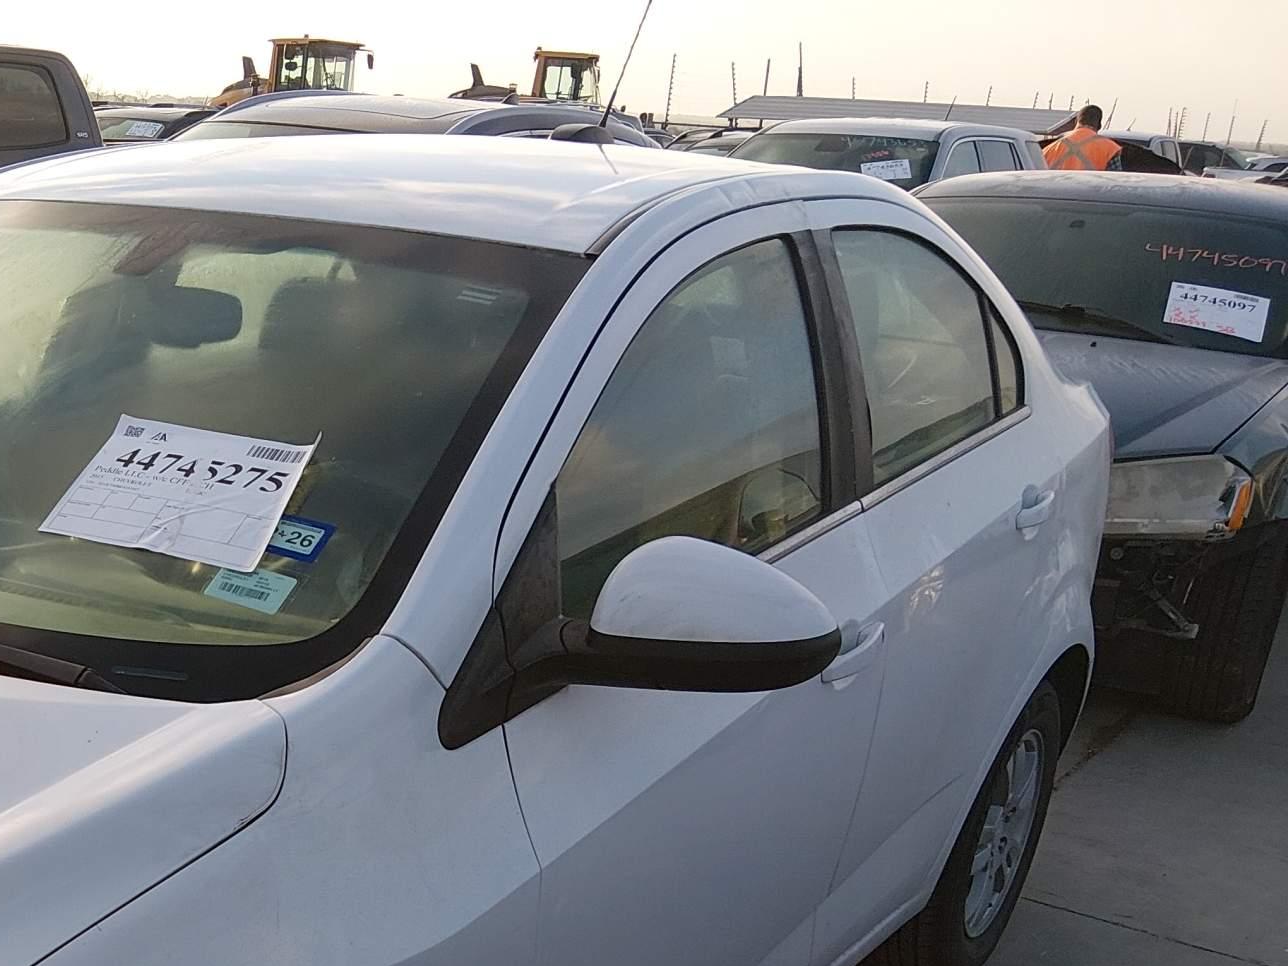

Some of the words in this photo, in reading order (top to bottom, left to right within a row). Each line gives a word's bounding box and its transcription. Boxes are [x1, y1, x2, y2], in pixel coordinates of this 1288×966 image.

[1144, 242, 1288, 276] 44745097
[1179, 292, 1257, 313] 44745097
[116, 448, 290, 493] 44745275
[285, 531, 316, 548] 26
